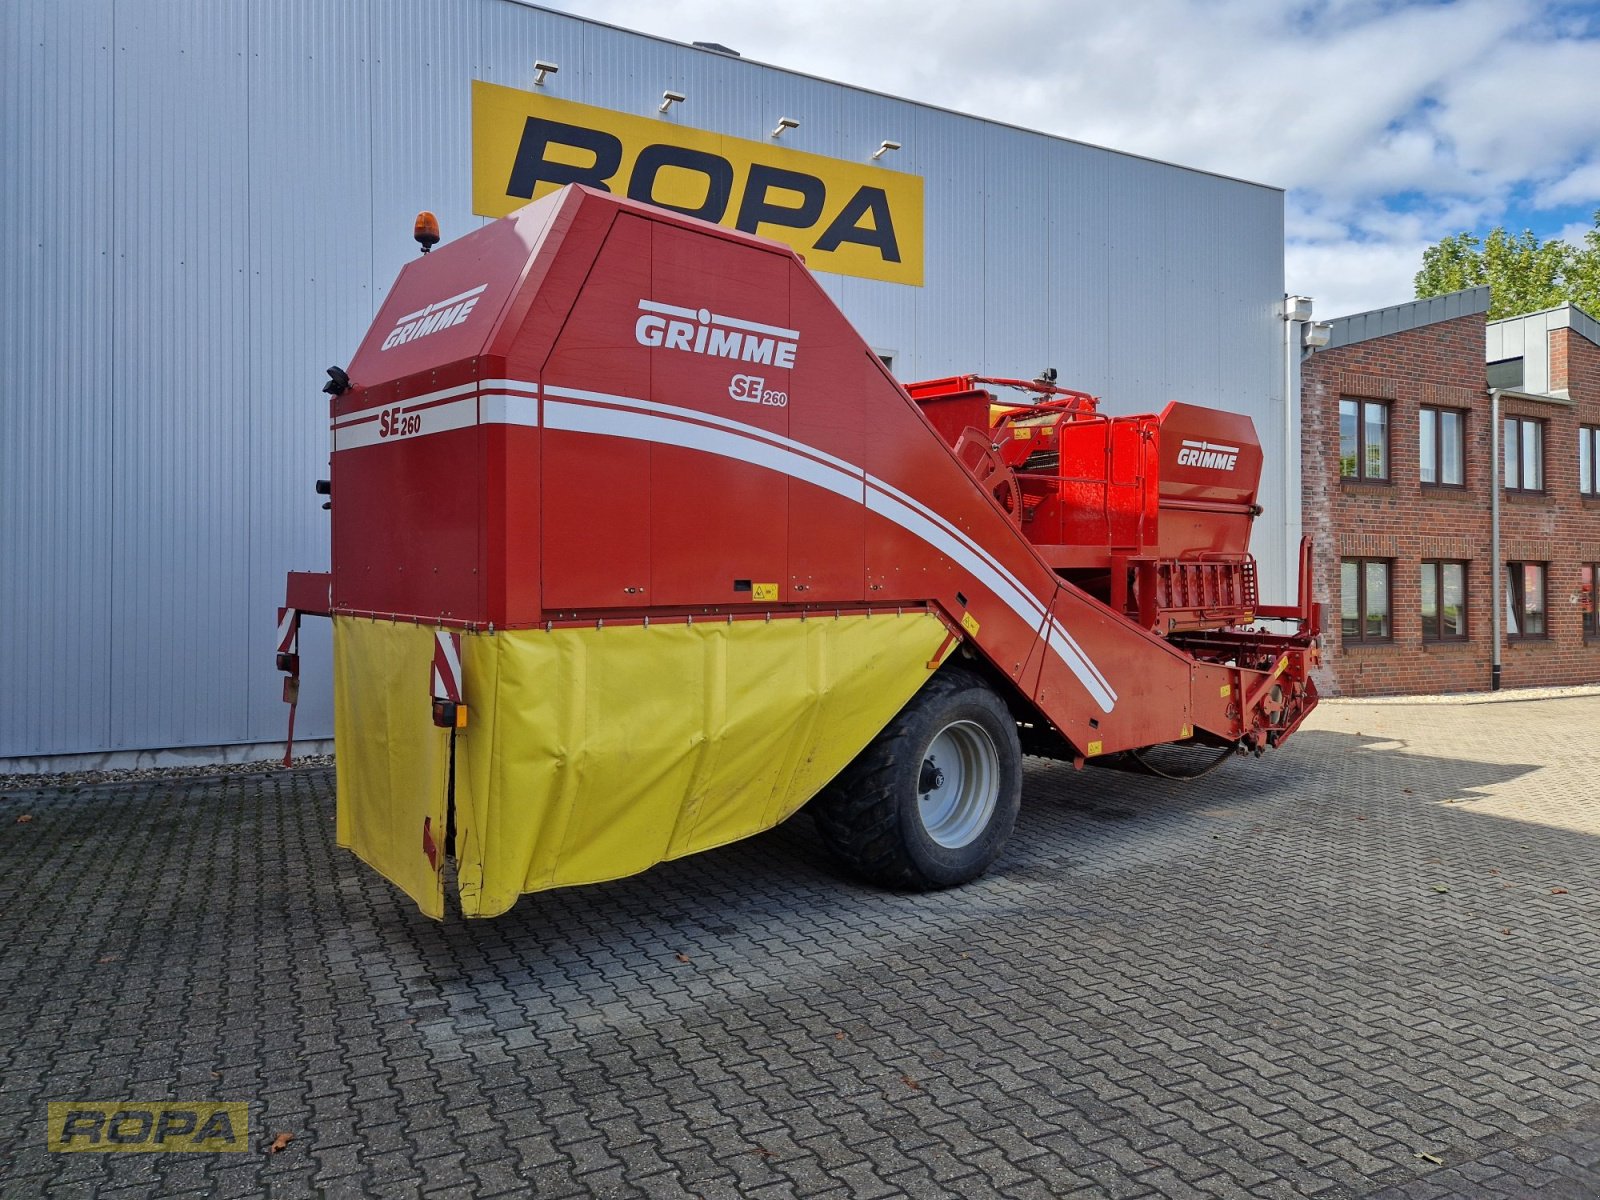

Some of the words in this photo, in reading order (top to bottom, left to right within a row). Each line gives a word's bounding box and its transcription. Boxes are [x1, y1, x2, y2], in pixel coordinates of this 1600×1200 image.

[505, 116, 902, 264] ROPA
[381, 296, 480, 351] GRIMME
[635, 308, 798, 369] GRIMME
[730, 375, 763, 402] SE
[763, 391, 787, 406] 260
[379, 407, 401, 438] SE
[401, 414, 421, 436] 260
[1177, 442, 1238, 471] GRIMME
